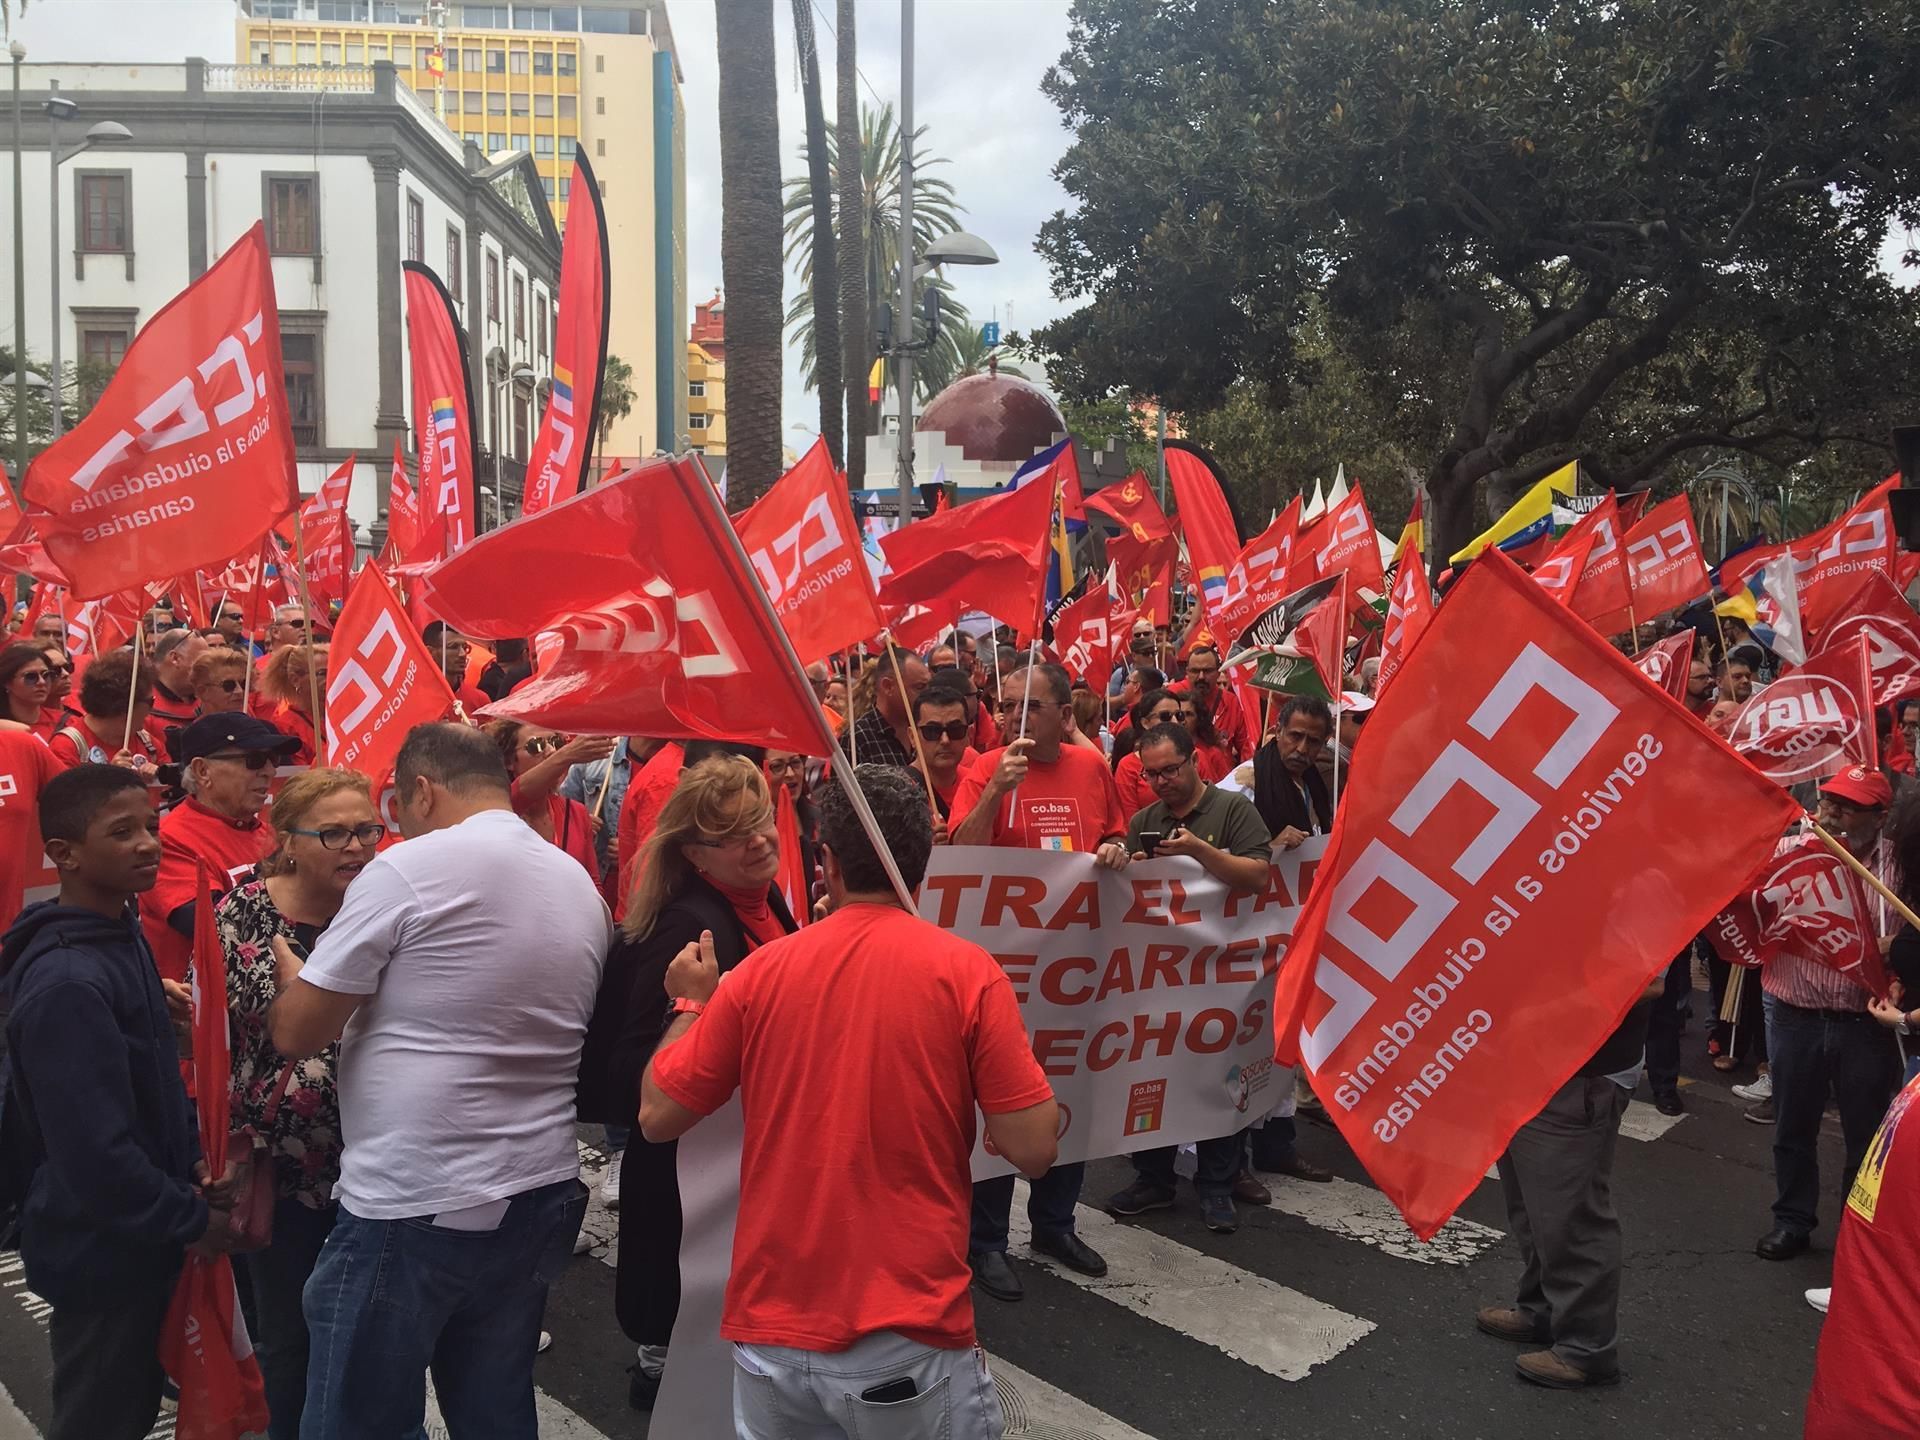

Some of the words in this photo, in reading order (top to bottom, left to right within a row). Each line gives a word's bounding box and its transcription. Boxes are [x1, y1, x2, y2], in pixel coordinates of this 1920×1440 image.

[1030, 802, 1072, 814] co.bas
[913, 874, 1101, 931] TRA
[1122, 878, 1203, 927] EL
[1133, 1083, 1162, 1097] co.bas
